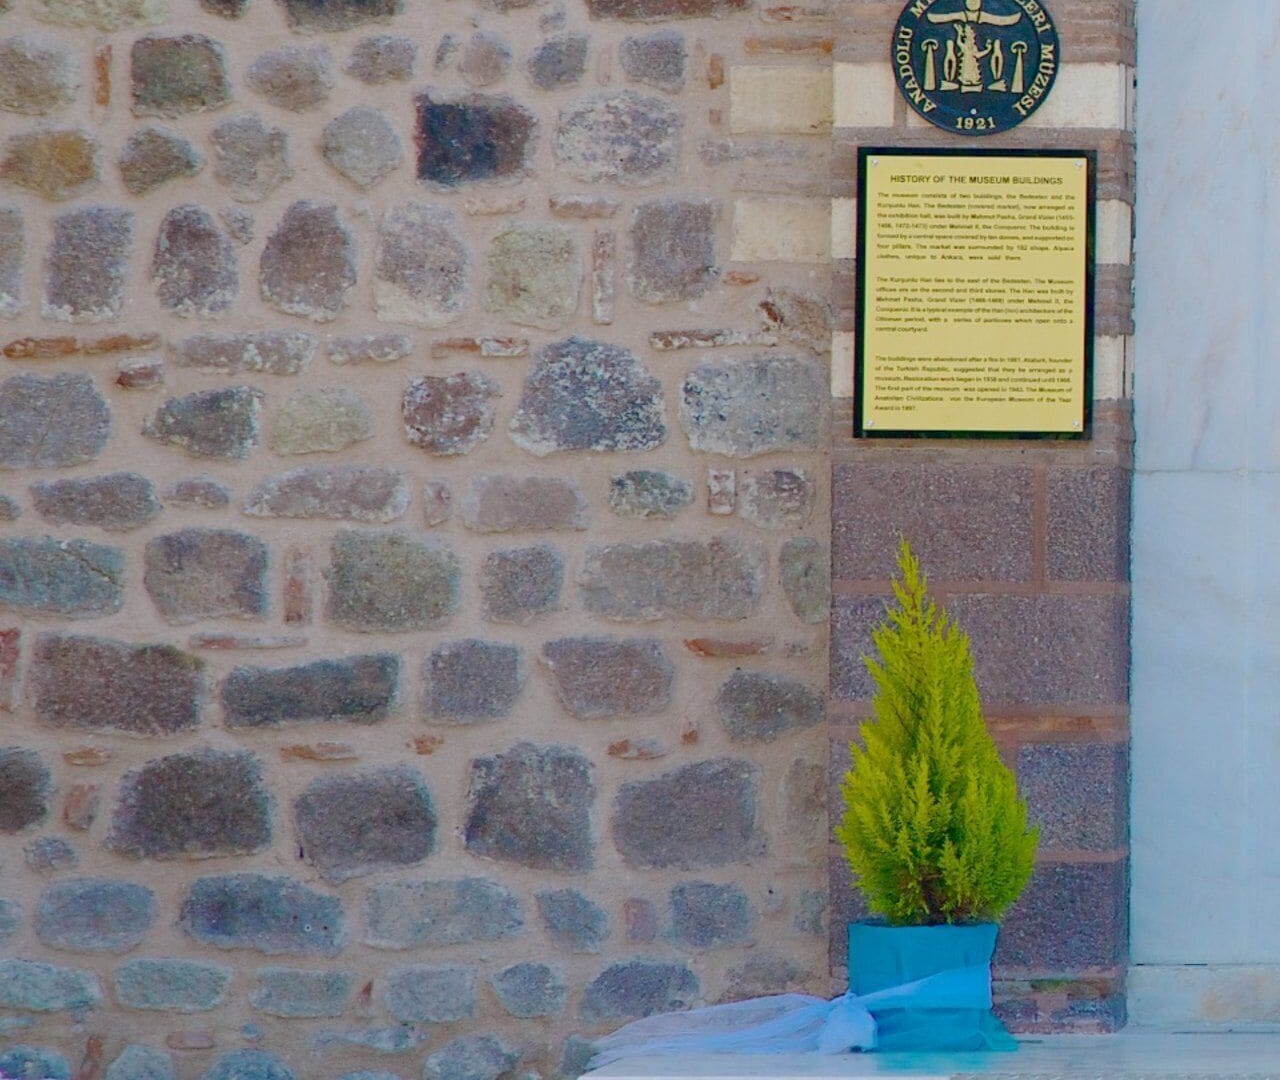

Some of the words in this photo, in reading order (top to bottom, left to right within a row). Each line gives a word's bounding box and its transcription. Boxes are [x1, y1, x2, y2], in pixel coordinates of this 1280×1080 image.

[896, 25, 937, 114] ANADOLU
[1012, 43, 1056, 117] MÜZESİ
[955, 116, 996, 130] 1921
[890, 174, 930, 184] HISTORY
[932, 175, 946, 184] OF
[948, 176, 967, 184] THE
[969, 176, 1010, 185] MUSEUM
[1012, 176, 1064, 186] BUILDINGS
